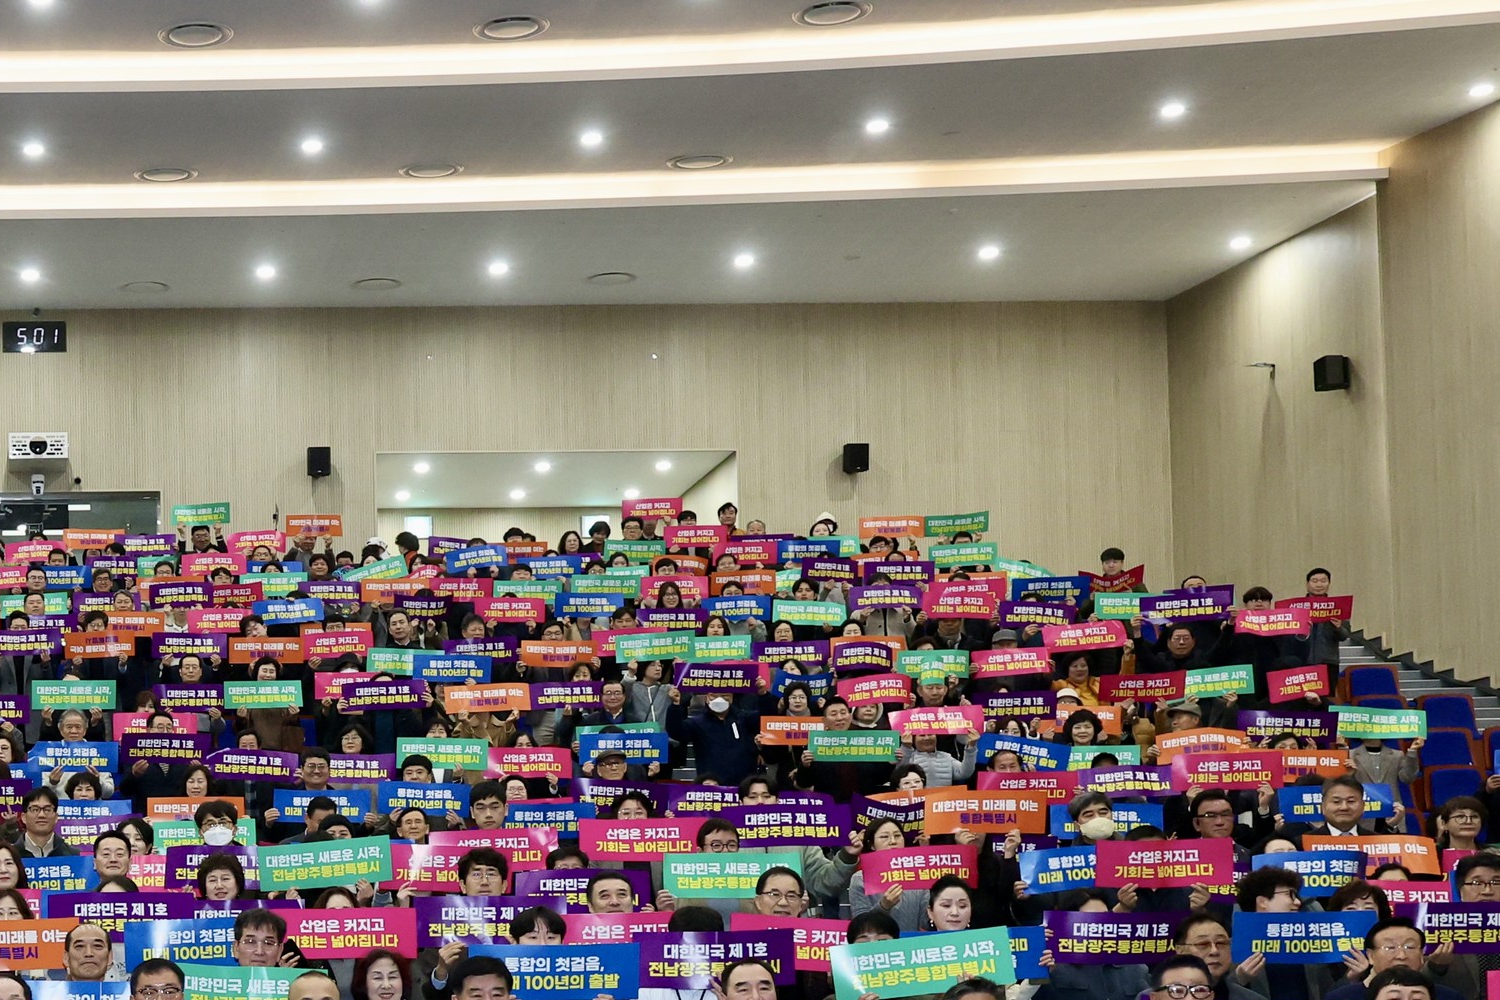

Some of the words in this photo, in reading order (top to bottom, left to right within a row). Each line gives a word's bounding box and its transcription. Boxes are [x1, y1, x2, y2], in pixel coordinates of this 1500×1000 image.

[46, 748, 71, 757] 통합의
[73, 748, 100, 758] 첫걸음,
[1095, 773, 1132, 782] 대한민국
[397, 787, 424, 798] 통합의
[426, 788, 454, 800] 첫걸음,
[933, 800, 979, 812] 대한민국
[983, 800, 1016, 811] 미래를
[1020, 800, 1038, 811] 여는
[745, 814, 793, 826] 대한민국
[960, 813, 1016, 824] 통합특별시
[606, 828, 639, 840] 산업은
[644, 827, 680, 839] 커지고
[596, 840, 629, 852] 기회는
[633, 840, 692, 853] 넓어집니다
[266, 852, 314, 866] 대한민국
[318, 849, 354, 865] 새로운
[359, 846, 383, 861] 시작,
[1163, 850, 1198, 863] 커지고
[272, 862, 379, 882] 전남광주통합특별시
[1115, 867, 1154, 878] 기회는
[300, 918, 340, 933] 산업은
[345, 918, 384, 932] 커지고
[1073, 923, 1132, 938] 대한민국
[1266, 923, 1305, 936] 통합의
[1309, 921, 1349, 937] 첫걸음,
[332, 933, 398, 948] 넓어집니다
[1251, 938, 1281, 953] 미래
[1284, 938, 1333, 954] 100년의
[664, 943, 724, 959] 대한민국
[910, 946, 957, 965] 새로운
[963, 940, 999, 959] 시작,
[505, 957, 552, 972] 통합의
[558, 957, 604, 973] 첫걸음,
[185, 976, 242, 992] 대한민국
[524, 974, 584, 990] 100년의
[588, 973, 619, 988] 출발
